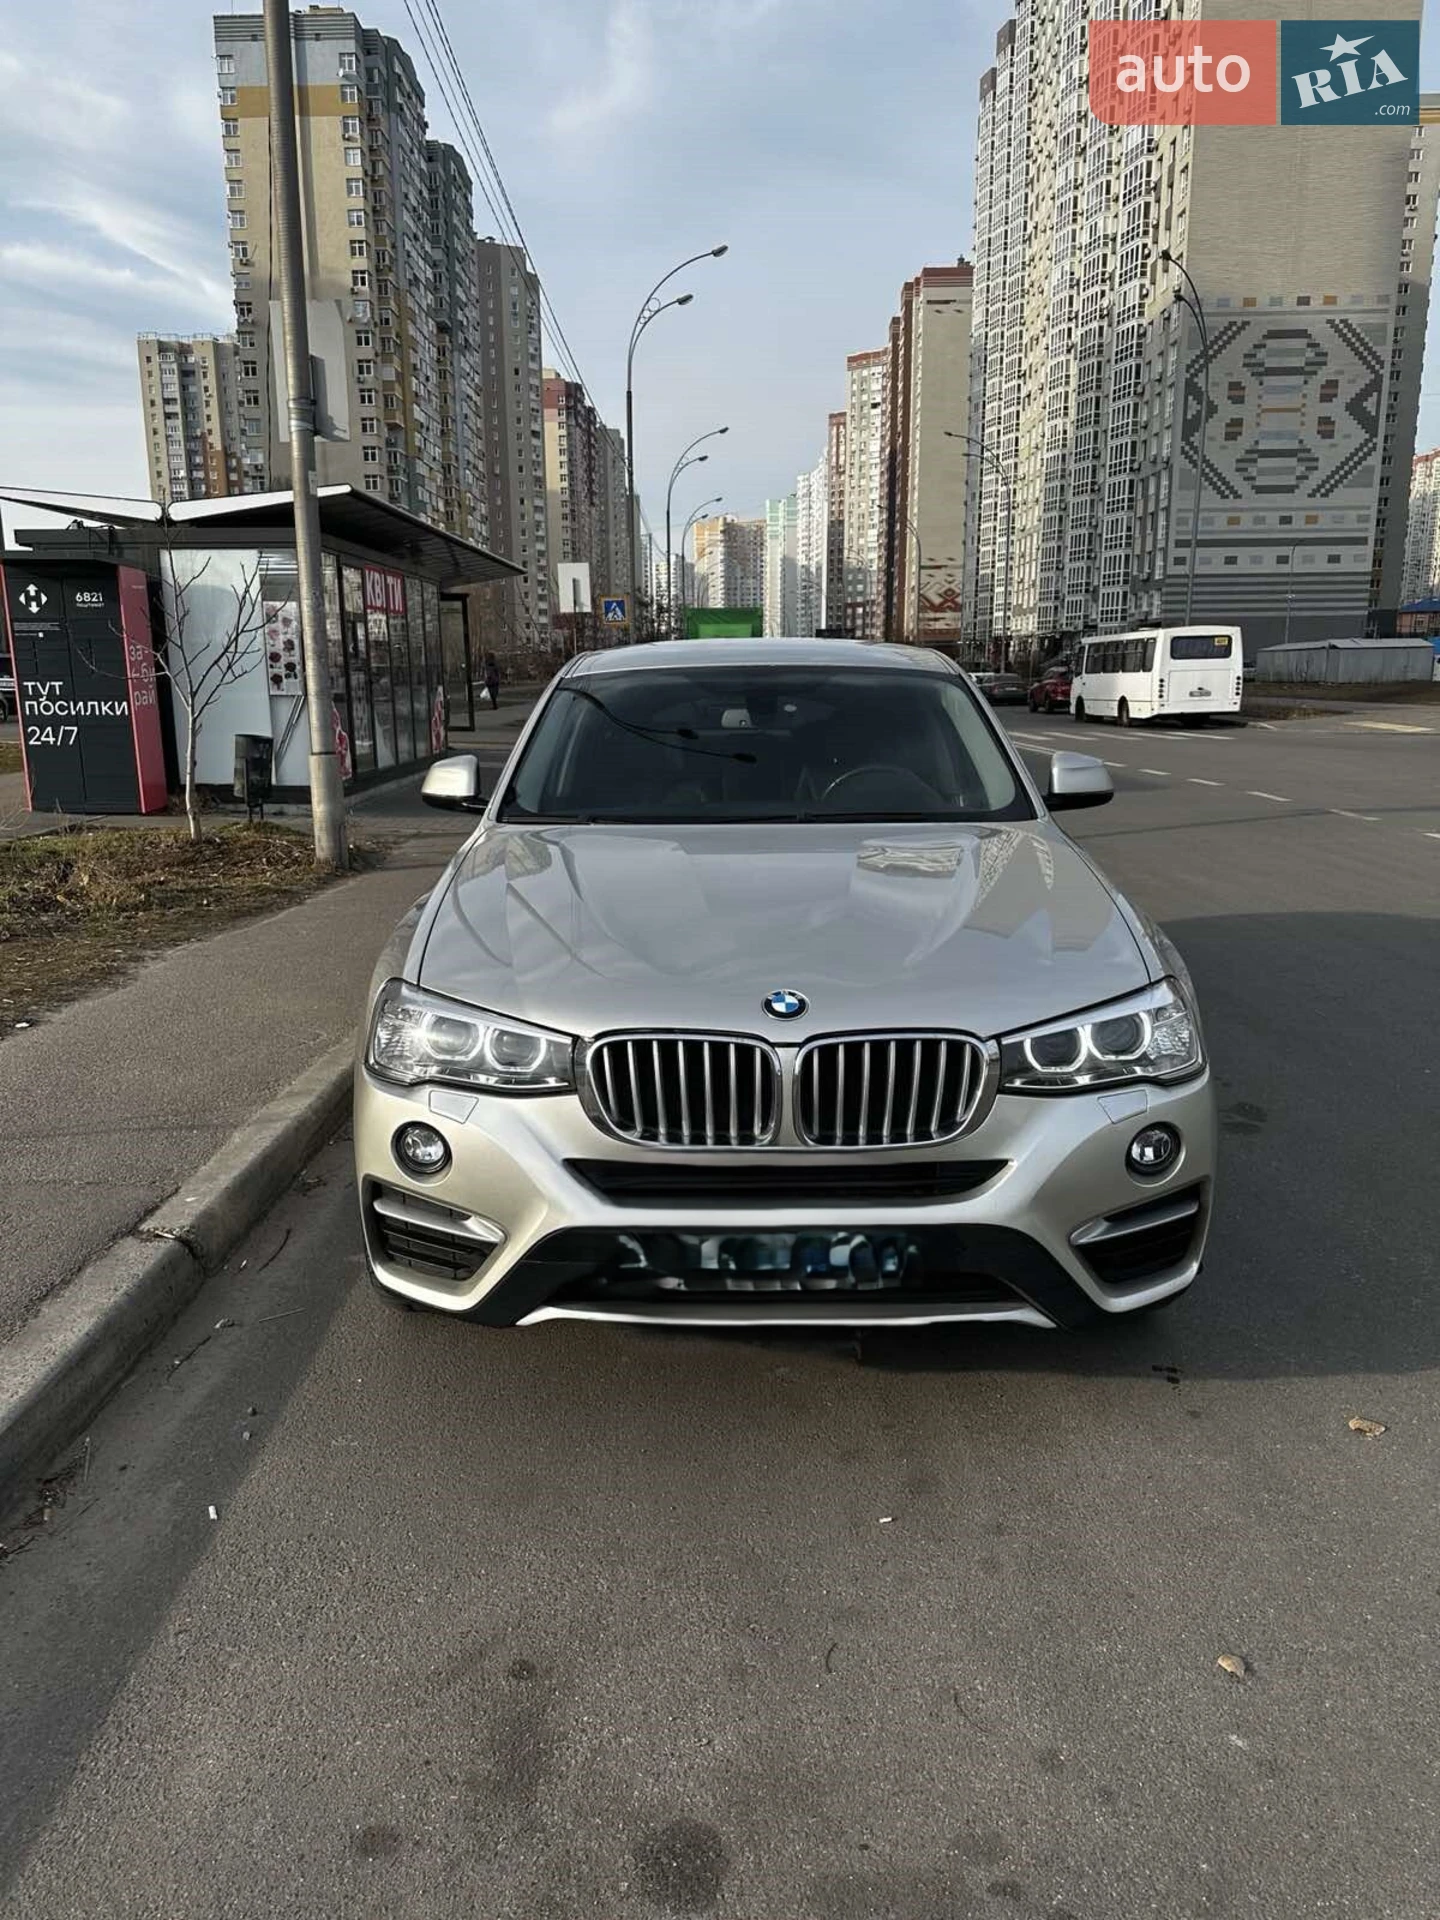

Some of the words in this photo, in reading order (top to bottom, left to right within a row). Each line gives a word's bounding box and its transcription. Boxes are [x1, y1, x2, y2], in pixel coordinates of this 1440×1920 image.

[75, 592, 103, 602] 6821
[365, 569, 403, 613] КВІТИ
[27, 725, 78, 746] 24/7
